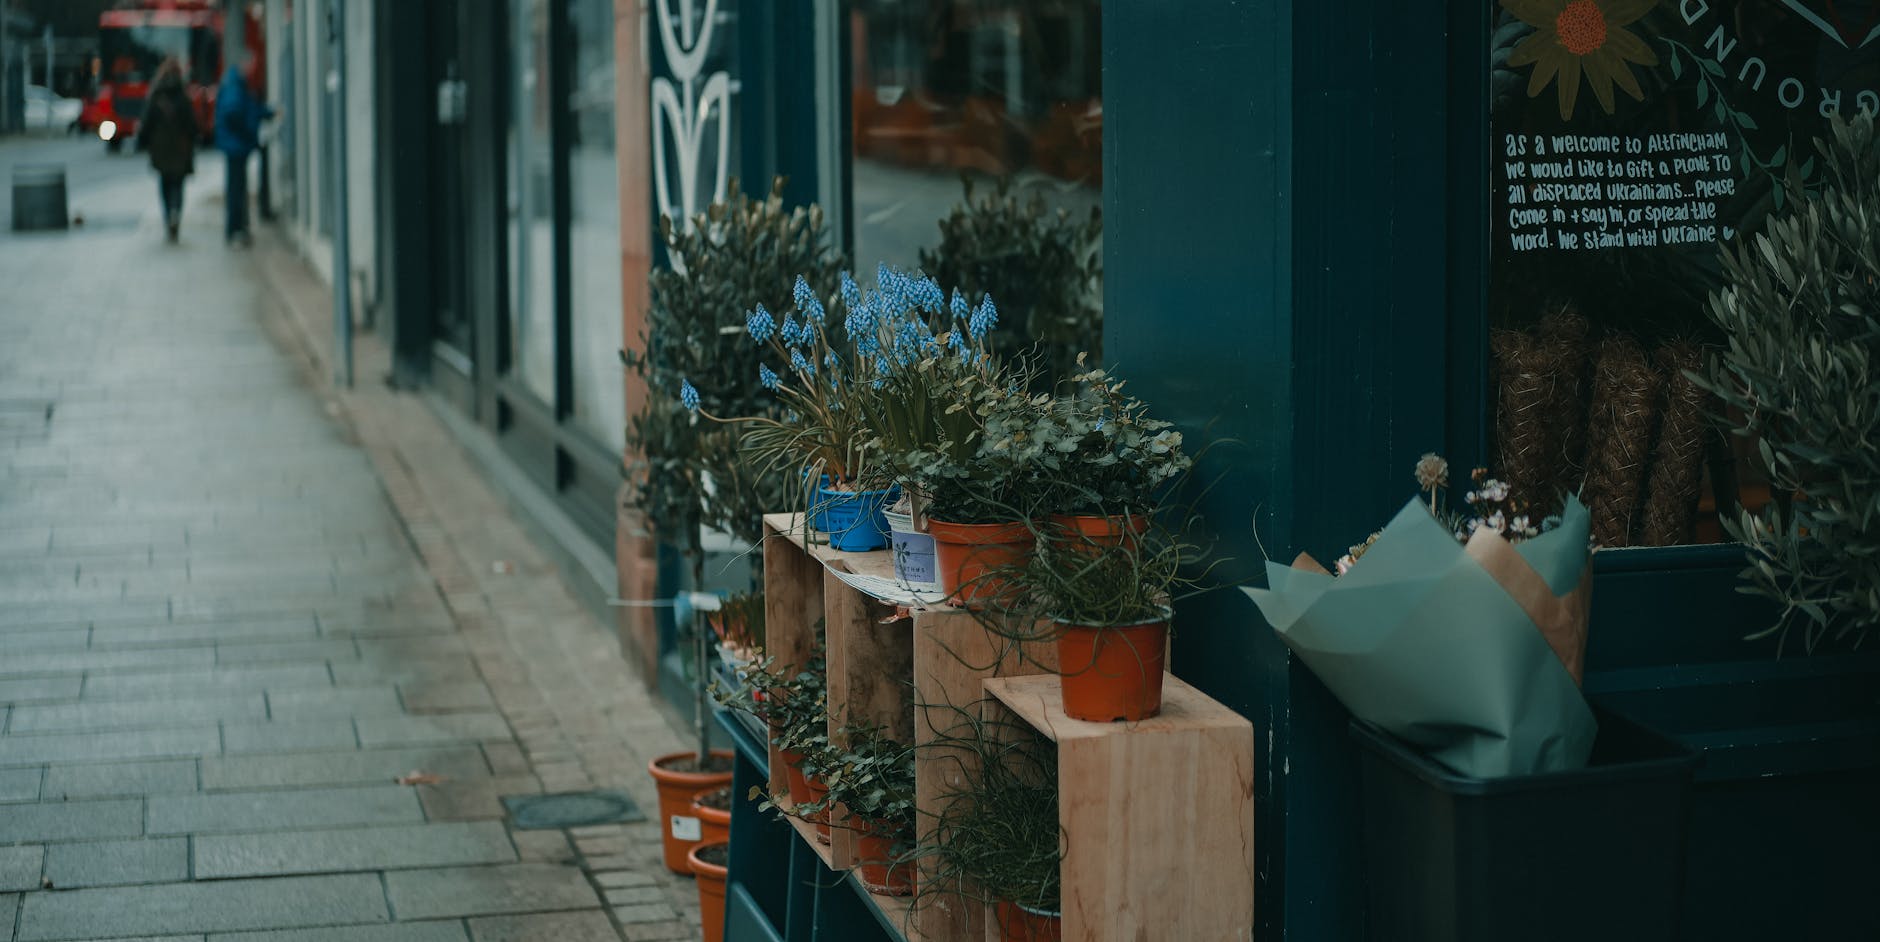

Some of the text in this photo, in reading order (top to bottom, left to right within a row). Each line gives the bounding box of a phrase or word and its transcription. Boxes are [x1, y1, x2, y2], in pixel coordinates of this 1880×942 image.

[1534, 135, 1545, 155] a
[1551, 134, 1620, 153] welcome
[1625, 136, 1642, 153] to
[1530, 158, 1573, 178] would
[1607, 159, 1623, 178] to
[1658, 161, 1670, 176] a
[1508, 184, 1526, 204] all
[1552, 204, 1565, 223] in
[1628, 208, 1642, 223] or
[1645, 205, 1689, 228] spread
